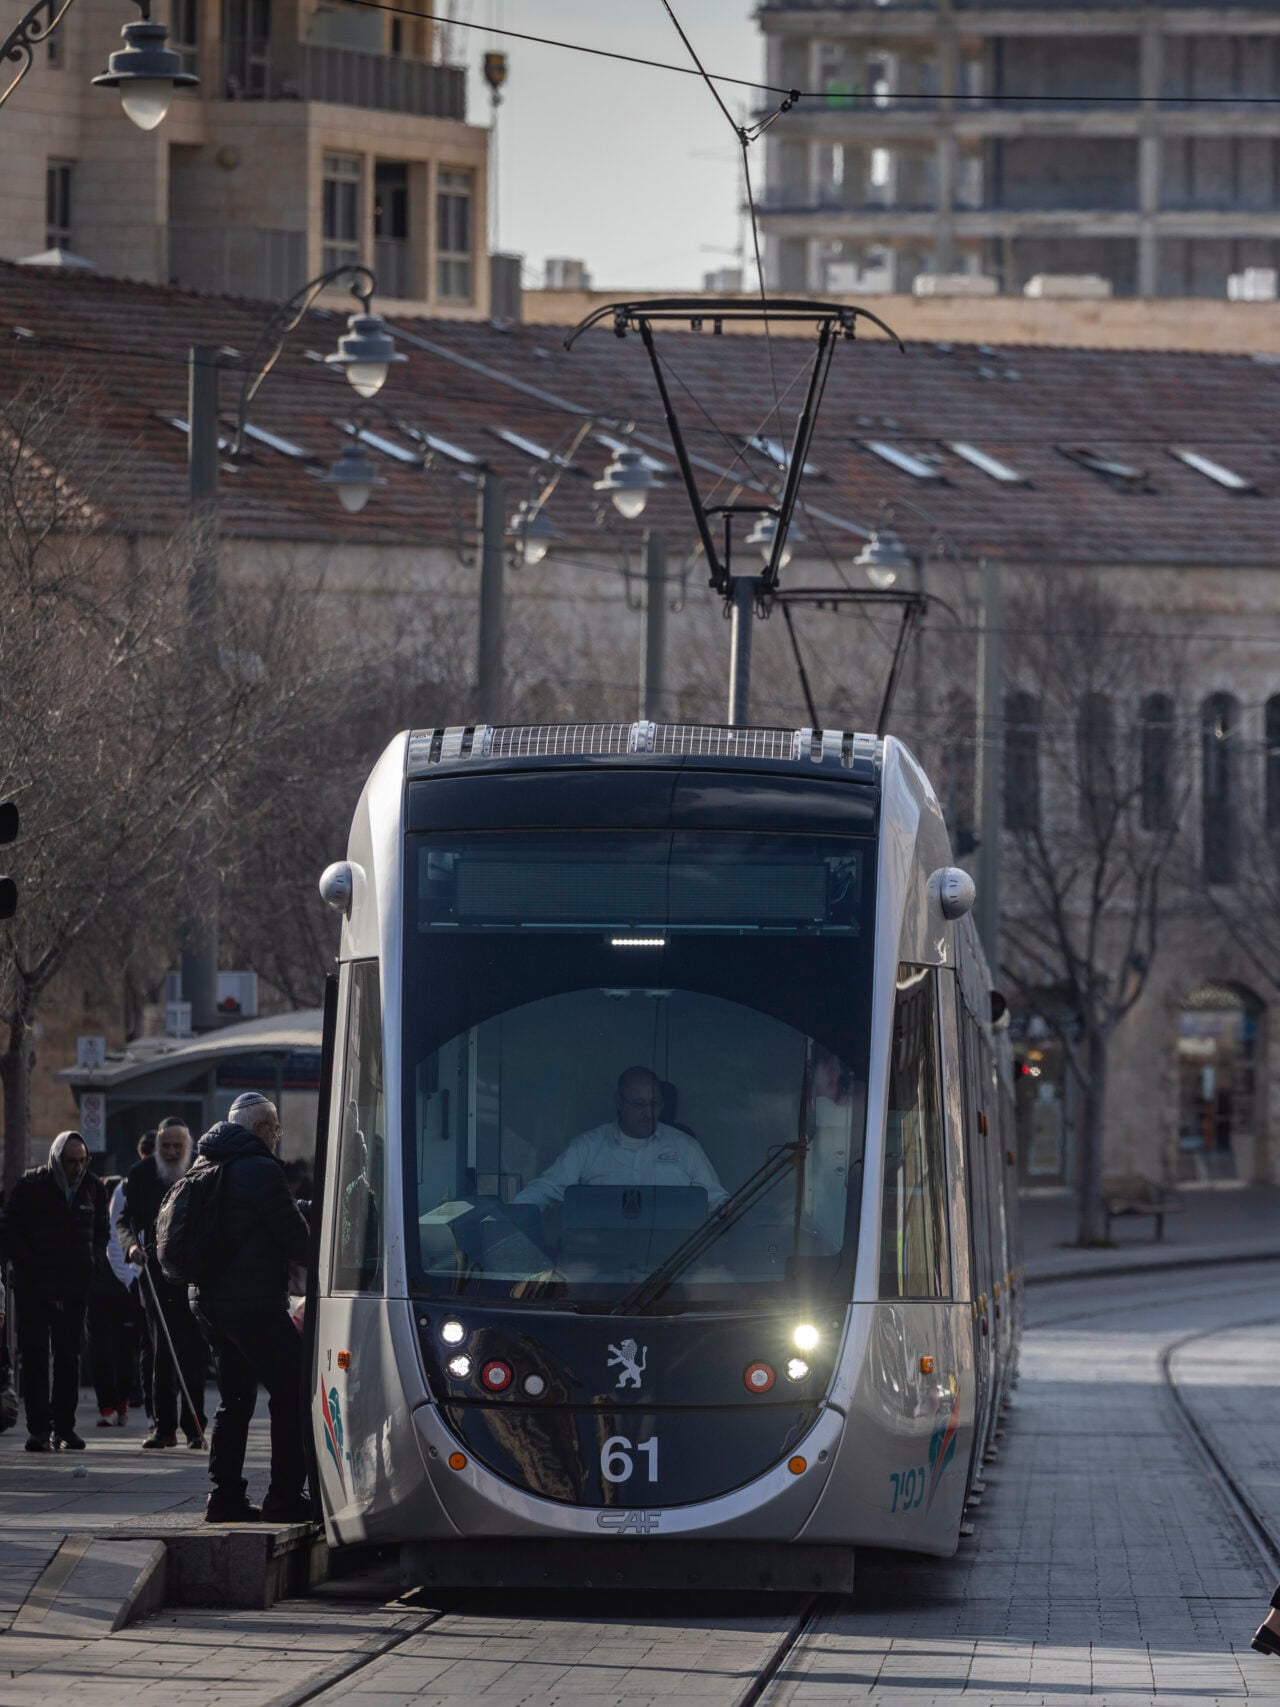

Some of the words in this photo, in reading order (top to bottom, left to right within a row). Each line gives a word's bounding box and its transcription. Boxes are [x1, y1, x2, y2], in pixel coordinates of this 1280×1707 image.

[600, 1435, 659, 1483] 61
[889, 1466, 926, 1513] כפיר
[597, 1510, 661, 1534] CAF
